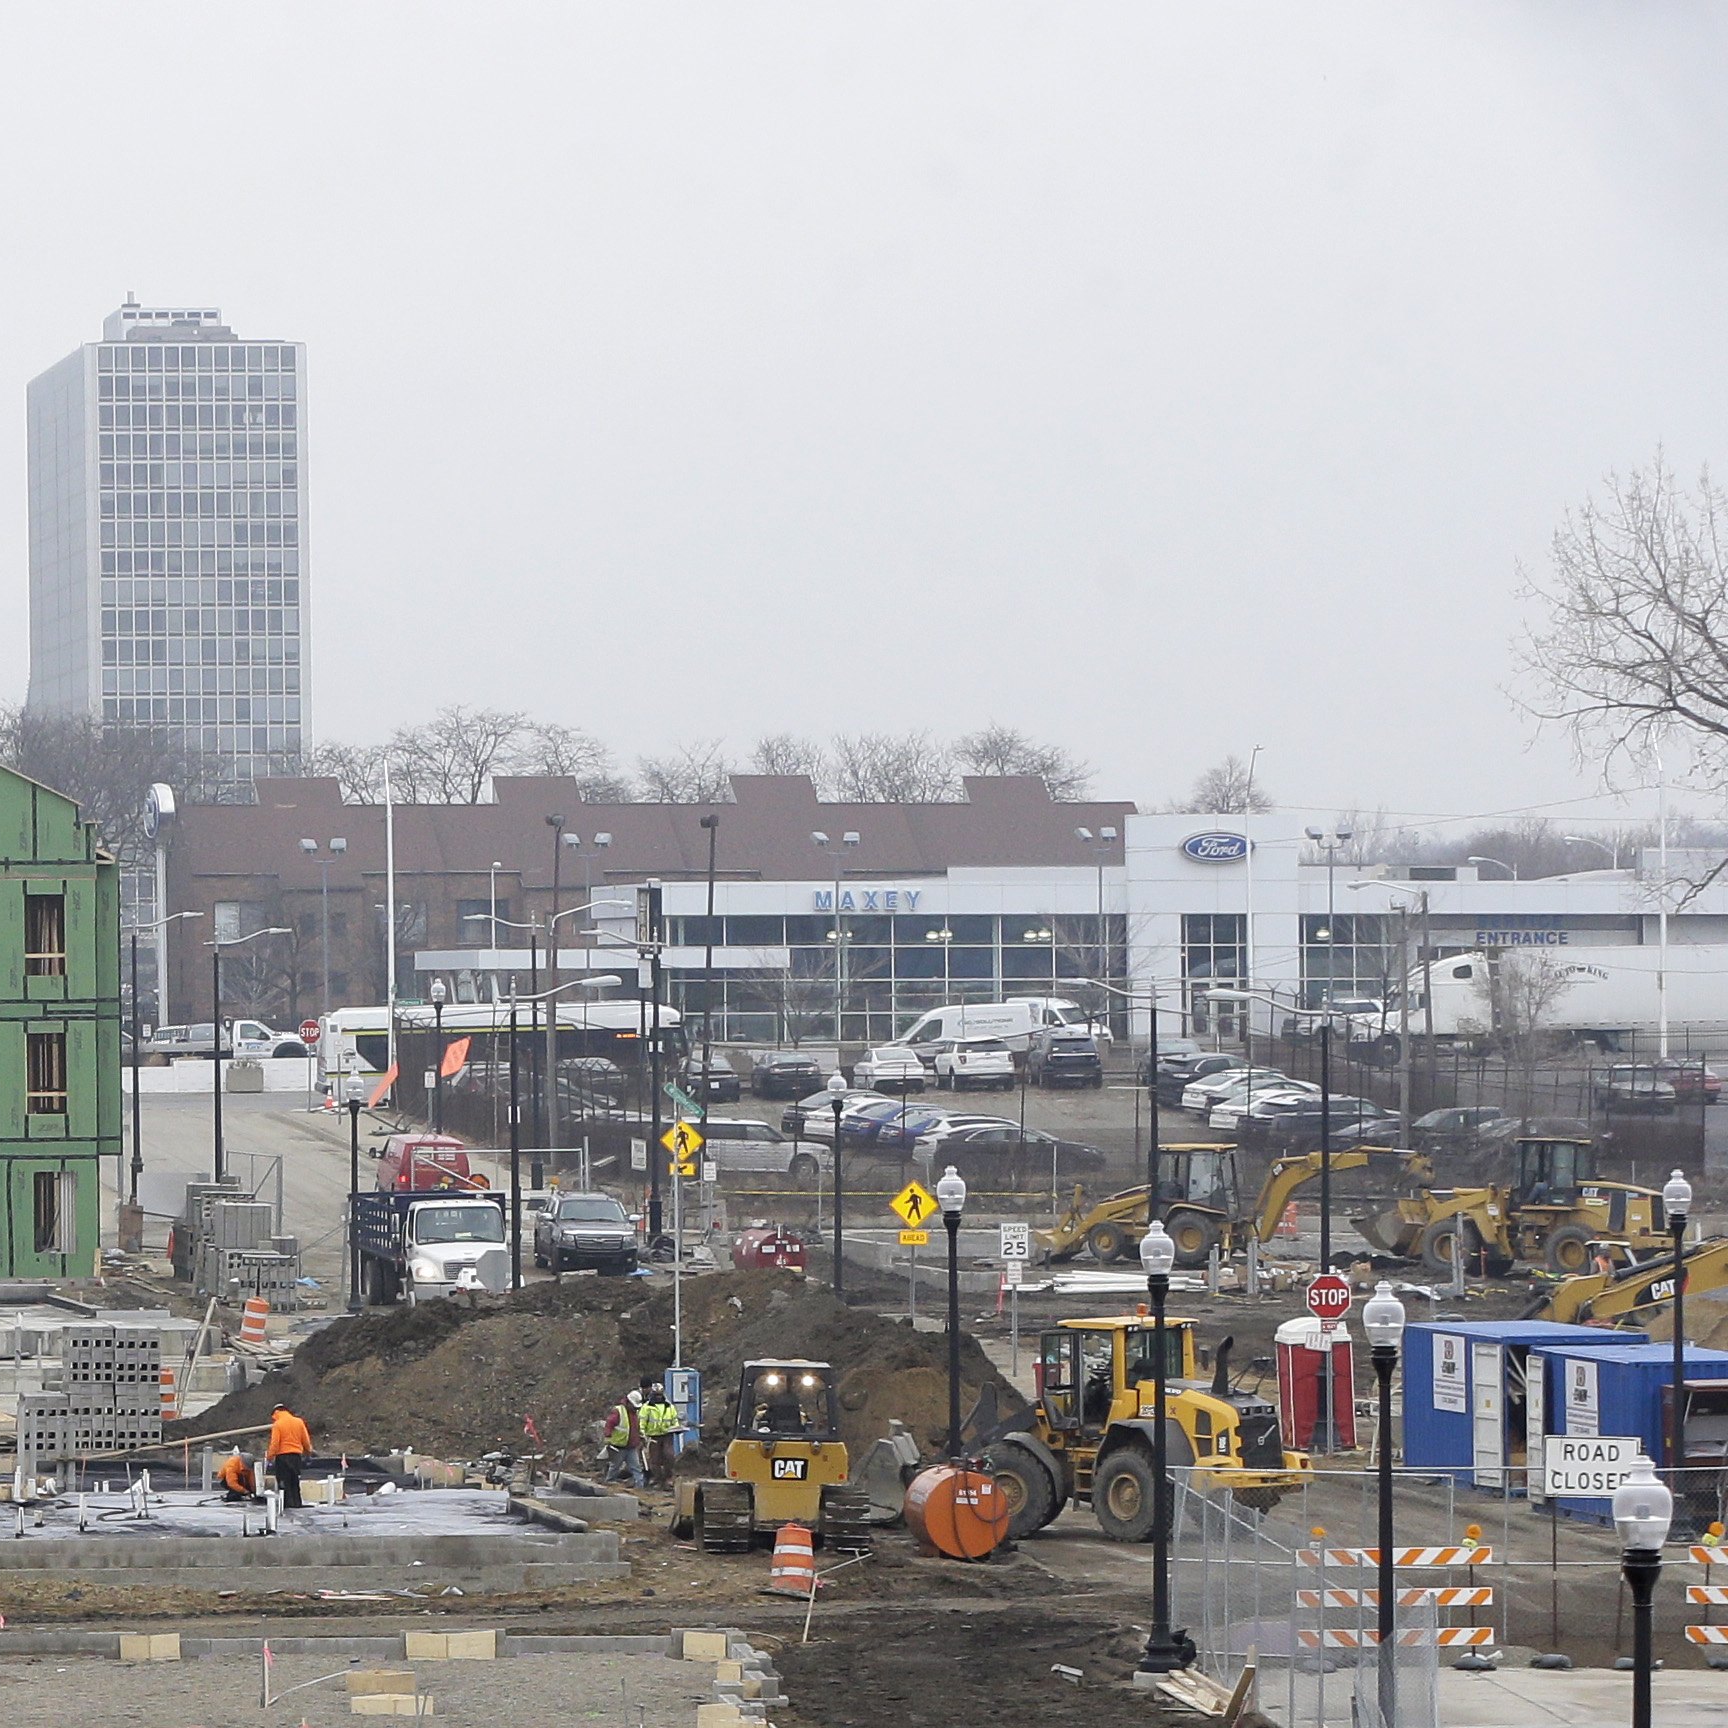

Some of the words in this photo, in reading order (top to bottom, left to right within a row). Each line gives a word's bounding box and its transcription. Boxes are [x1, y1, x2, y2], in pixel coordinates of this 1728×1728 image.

[1197, 837, 1242, 856] Ford
[814, 889, 921, 909] MAXEY
[1476, 931, 1569, 945] ENTRANCE
[300, 1027, 320, 1037] STOP
[902, 1234, 925, 1242] AHEAD
[1003, 1241, 1026, 1255] 25
[1310, 1288, 1348, 1306] STOP
[1651, 1279, 1676, 1300] CAT
[1563, 1443, 1620, 1461] ROAD
[774, 1459, 805, 1479] CAT
